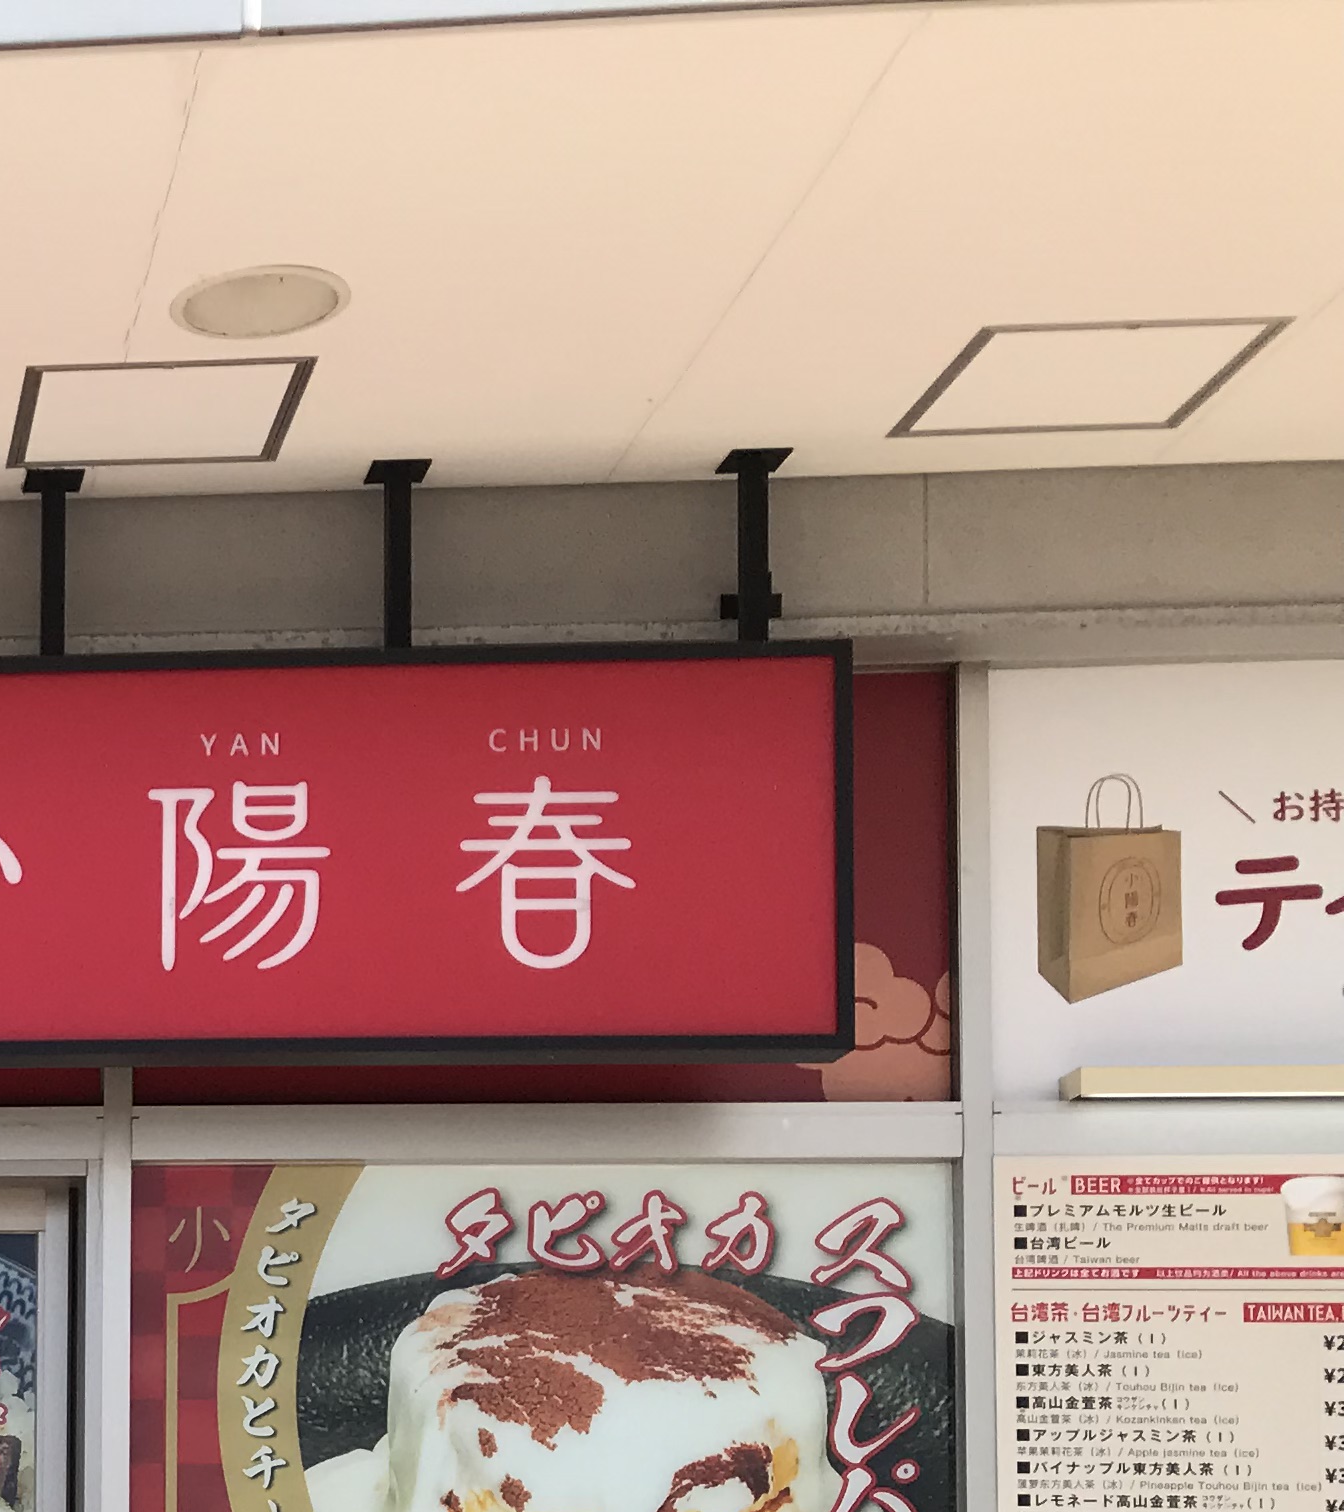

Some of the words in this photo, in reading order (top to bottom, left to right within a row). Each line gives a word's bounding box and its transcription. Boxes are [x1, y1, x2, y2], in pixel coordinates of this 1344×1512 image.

[200, 732, 281, 757] YAN
[487, 727, 604, 753] CHUN
[1012, 1176, 1057, 1195] ビール
[1074, 1177, 1122, 1194] BEER
[438, 1186, 776, 1279] タピオカ
[1244, 1222, 1269, 1232] beer
[1029, 1236, 1112, 1250] 台湾ビール
[1073, 1255, 1112, 1264] Taiwan
[1115, 1255, 1141, 1264] beer
[1247, 1304, 1305, 1321] TAIWAN
[1189, 1416, 1208, 1425] tea
